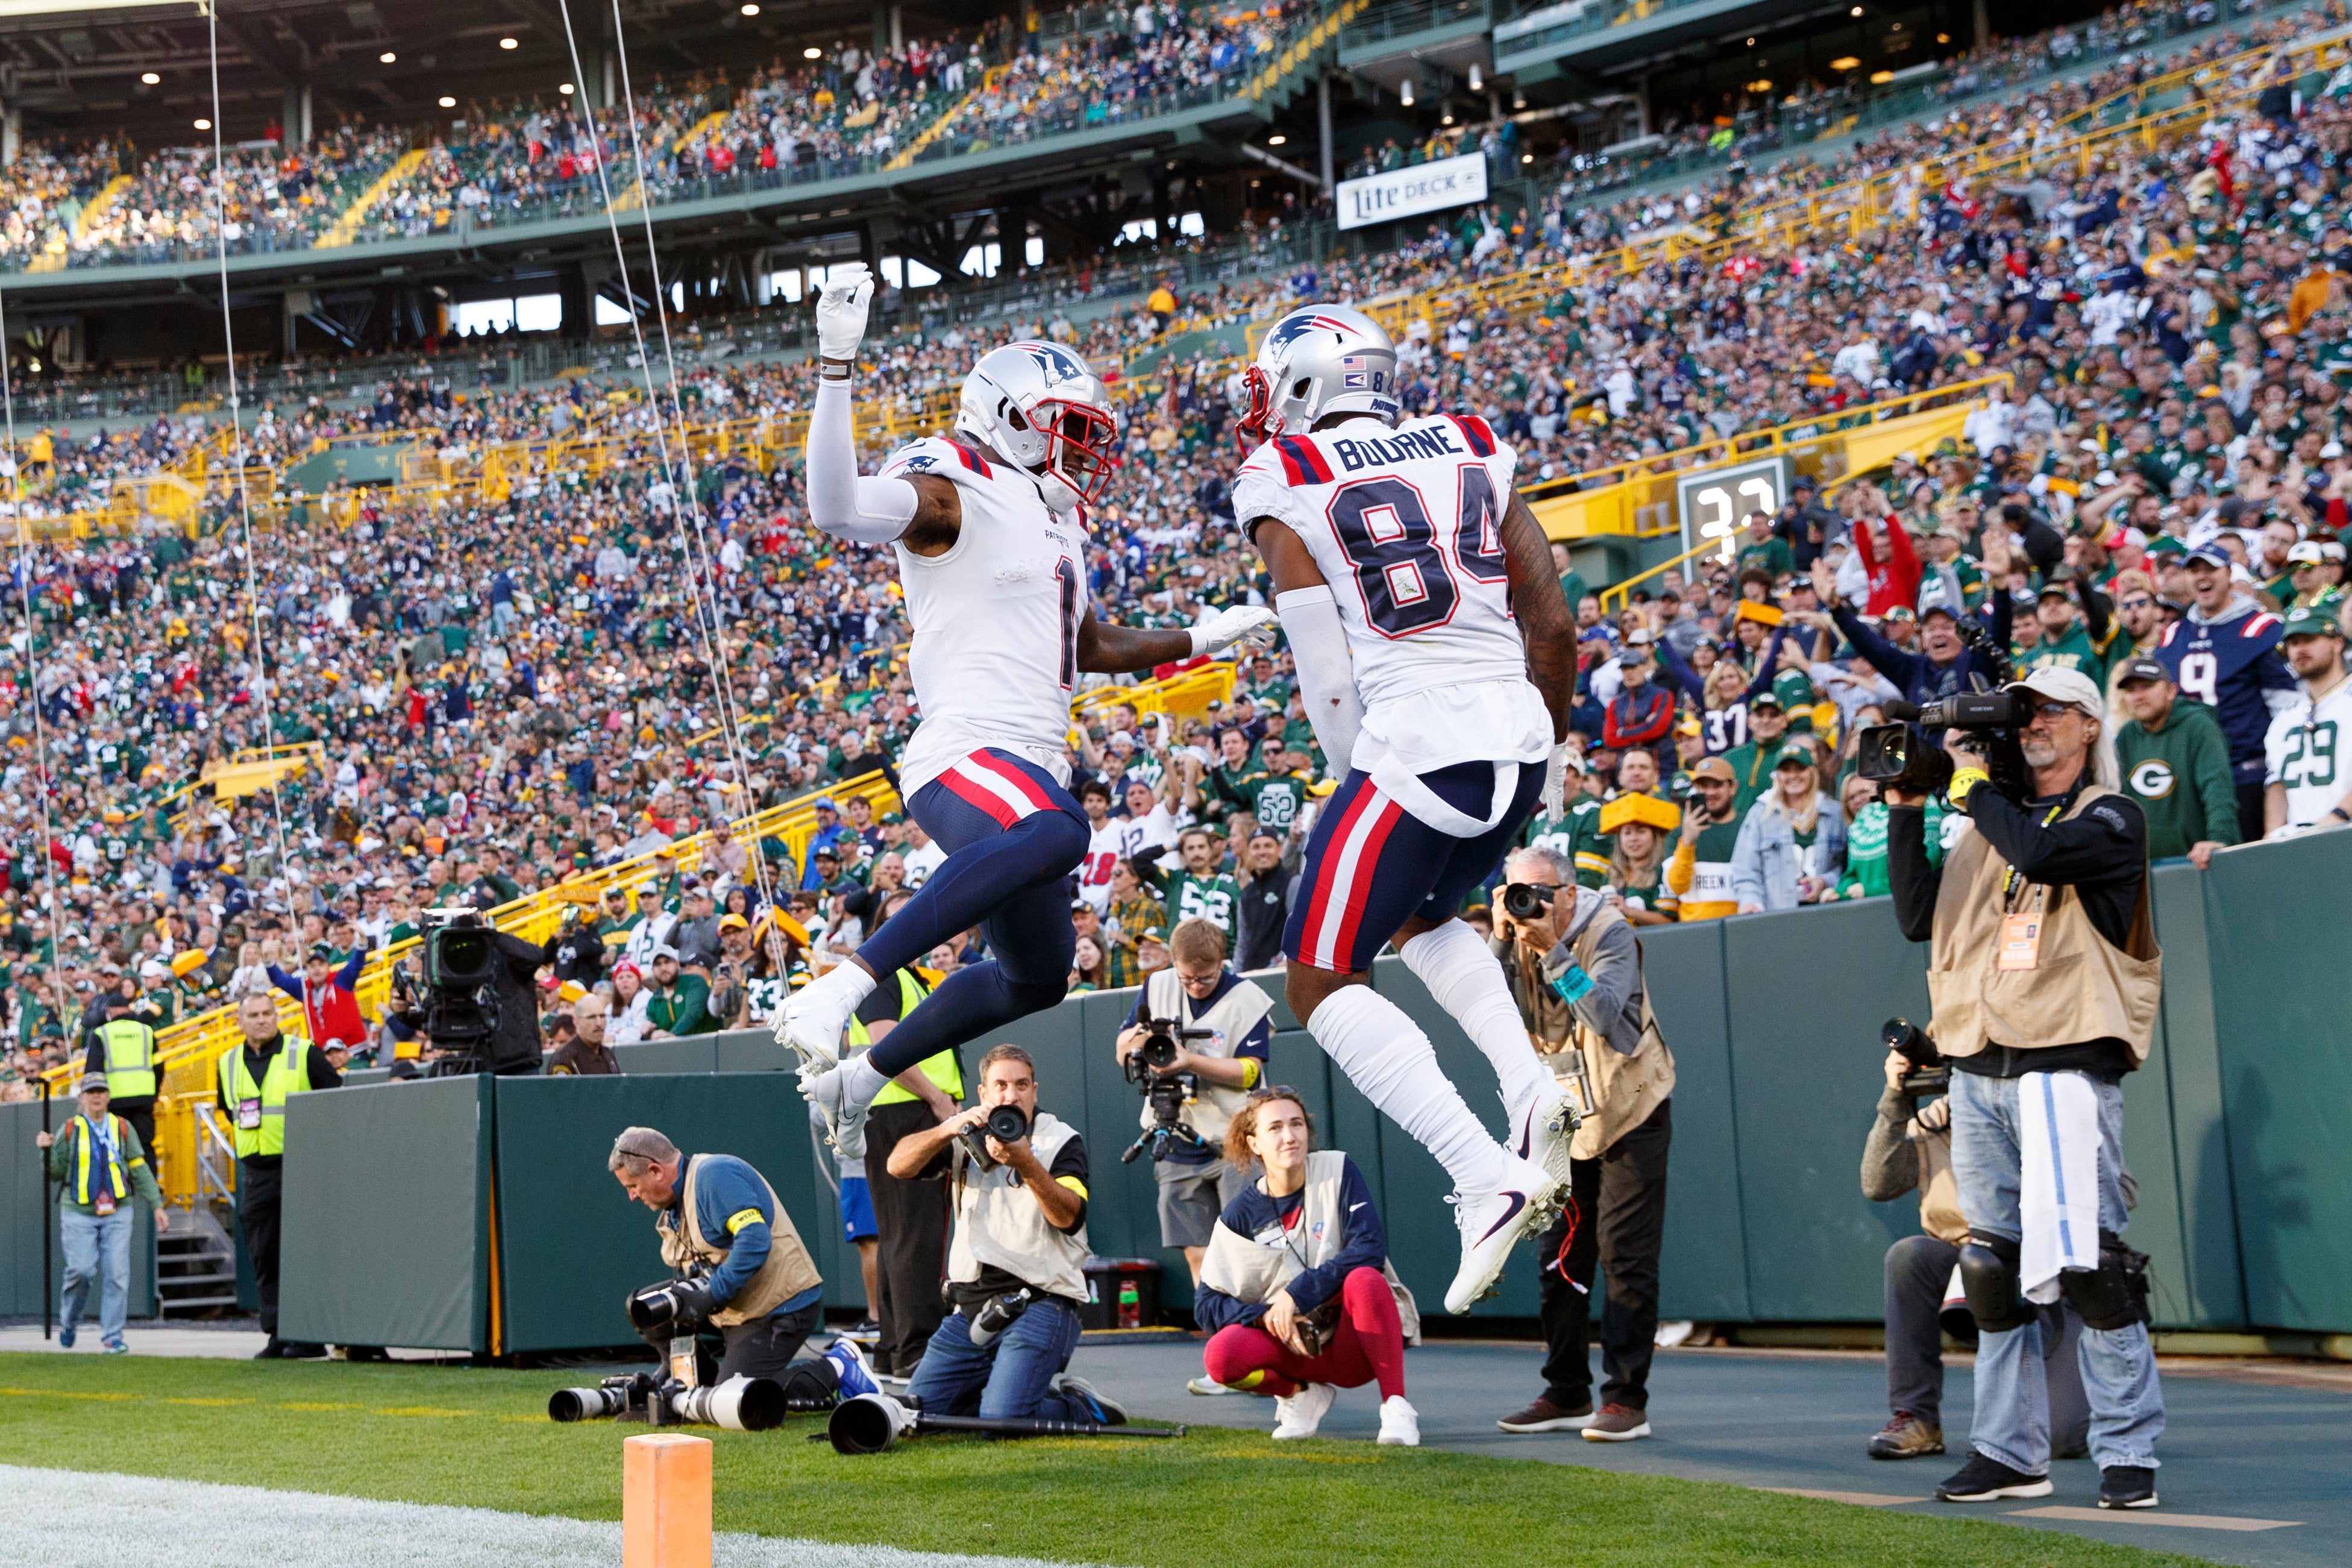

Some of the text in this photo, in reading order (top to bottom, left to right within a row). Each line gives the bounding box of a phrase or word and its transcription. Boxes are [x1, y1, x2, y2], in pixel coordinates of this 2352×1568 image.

[1355, 186, 1398, 219] Lite
[1405, 175, 1456, 199] DECK
[1332, 424, 1464, 472] BOURNE
[1325, 462, 1515, 641] 84
[1055, 554, 1079, 691] 1
[2178, 651, 2218, 706] 9
[1706, 703, 1748, 751] 37
[2281, 721, 2338, 788] 29
[1257, 791, 1296, 827] 52
[1695, 874, 1725, 889] REEN
[1179, 881, 1232, 932] 52
[636, 935, 655, 965] 12
[748, 977, 786, 1021] 33
